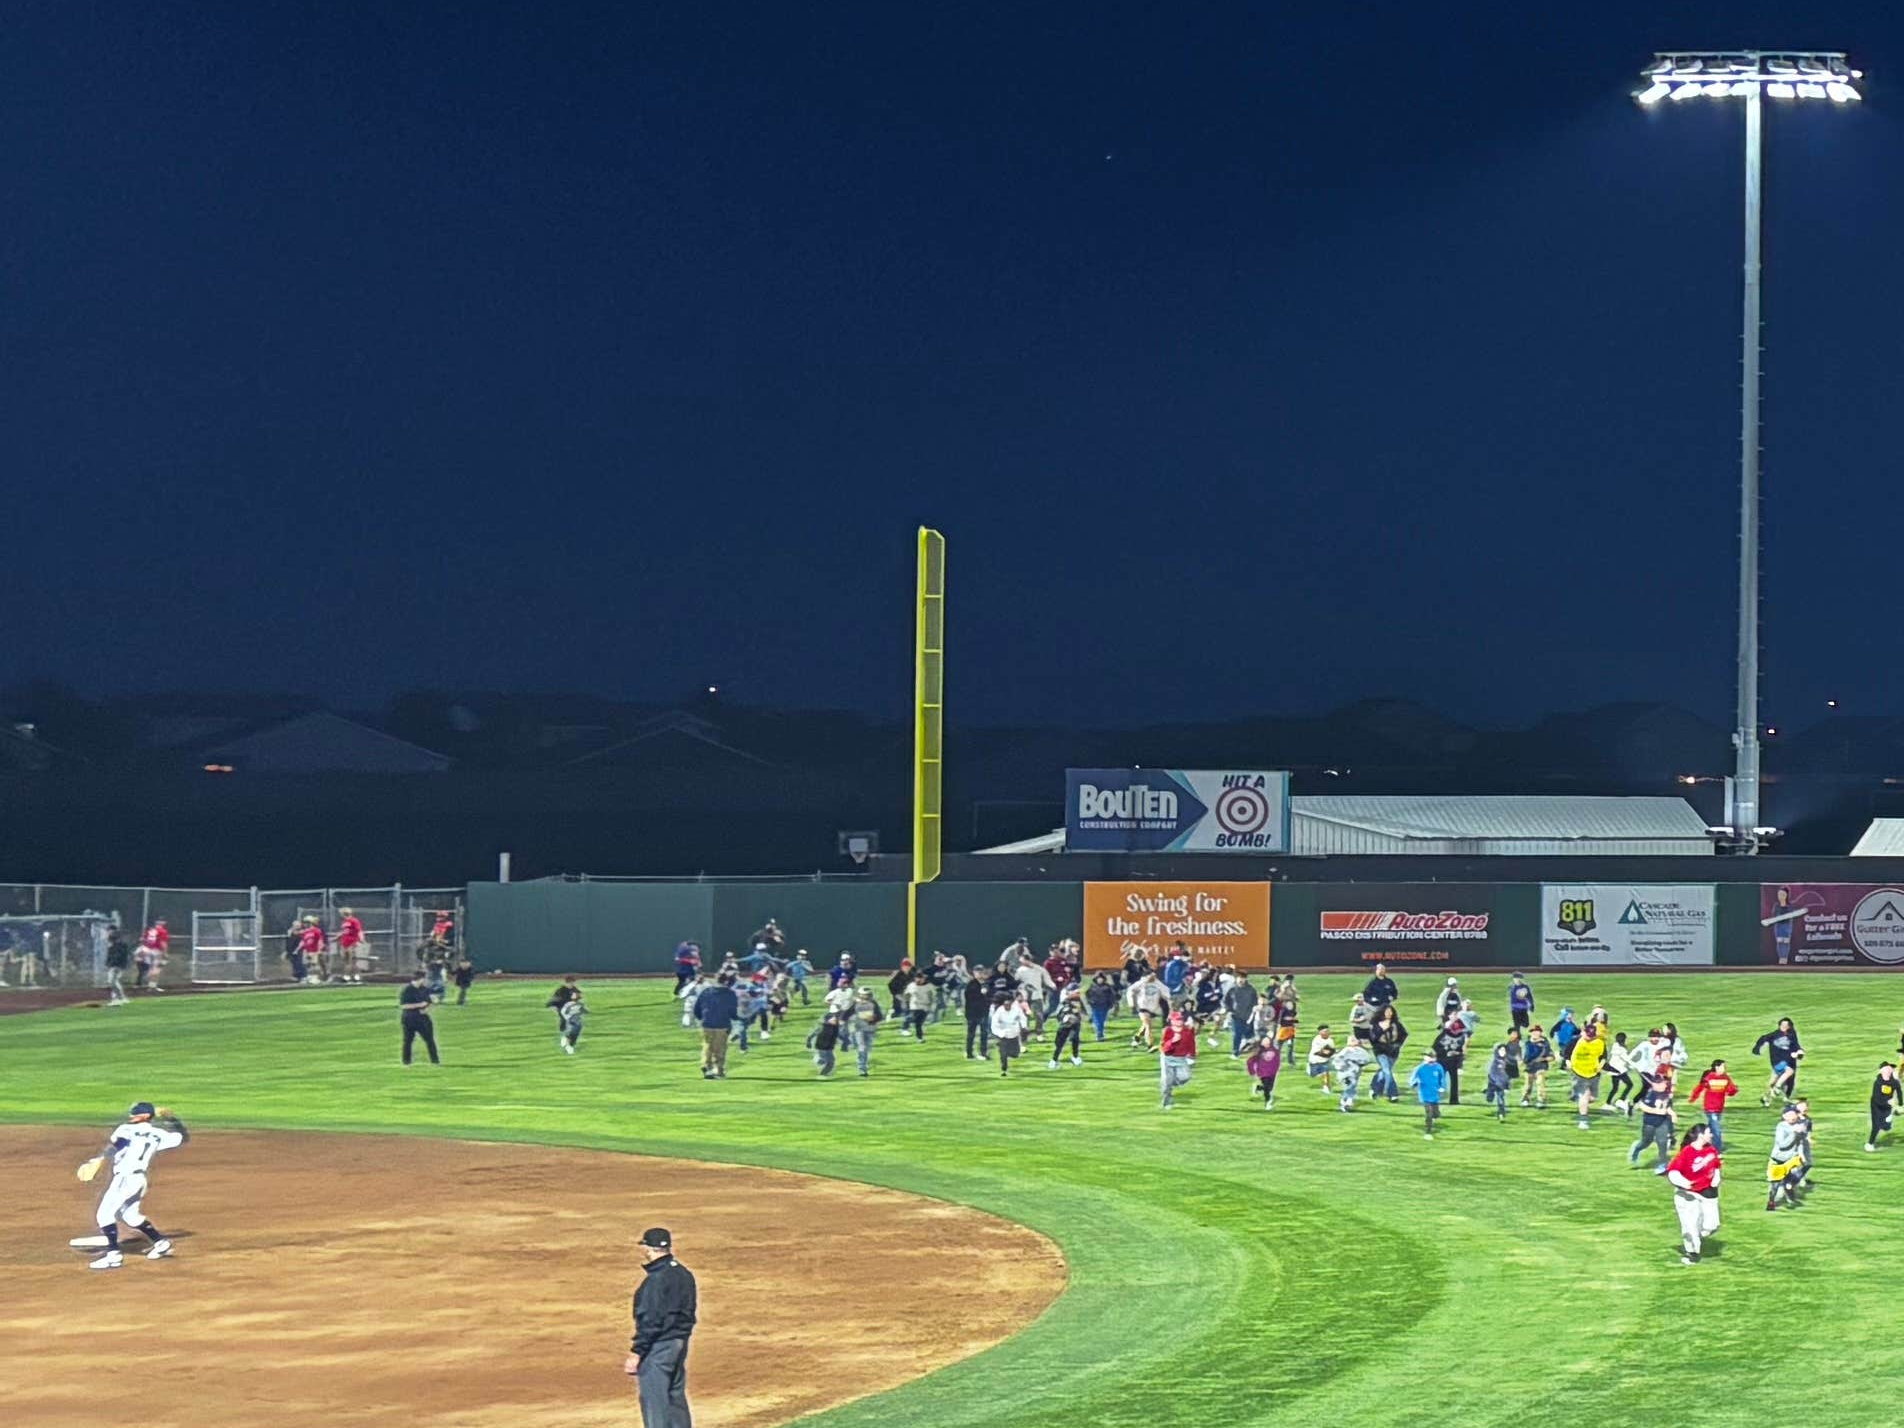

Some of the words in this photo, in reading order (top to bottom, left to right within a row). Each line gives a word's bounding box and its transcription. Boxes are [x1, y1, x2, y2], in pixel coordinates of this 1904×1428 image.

[1222, 774, 1246, 788] HIT
[1251, 775, 1266, 789] A
[1215, 833, 1272, 847] BOMB!
[1126, 893, 1188, 917] Swing
[1195, 892, 1228, 912] for
[1561, 900, 1592, 922] 811
[1107, 917, 1139, 935] the
[1147, 916, 1248, 935] freshness.
[1390, 911, 1489, 931] AutoZone
[1320, 931, 1353, 939] PASCO
[1355, 931, 1424, 939] DISTRIBUTION
[1425, 931, 1463, 939] CENTER
